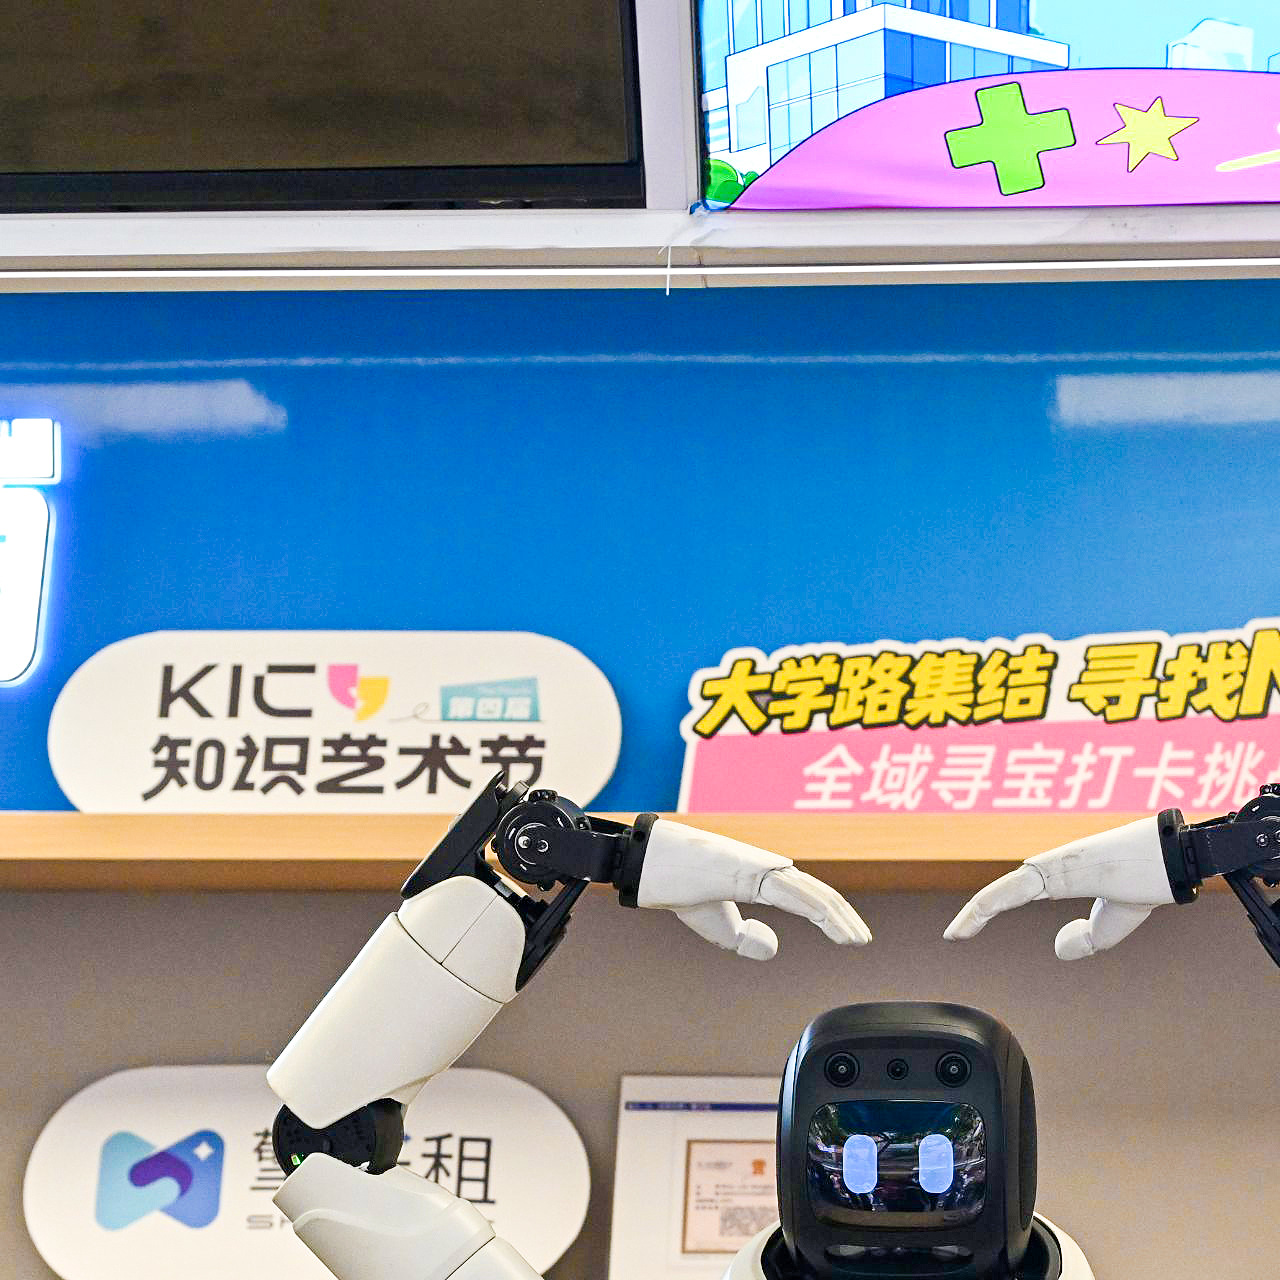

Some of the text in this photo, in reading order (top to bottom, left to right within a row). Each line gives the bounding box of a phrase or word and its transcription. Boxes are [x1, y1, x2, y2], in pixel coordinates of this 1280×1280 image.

[158, 663, 317, 718] KIC
[693, 643, 1056, 738] 大学路集结
[142, 733, 547, 801] 知识艺术节
